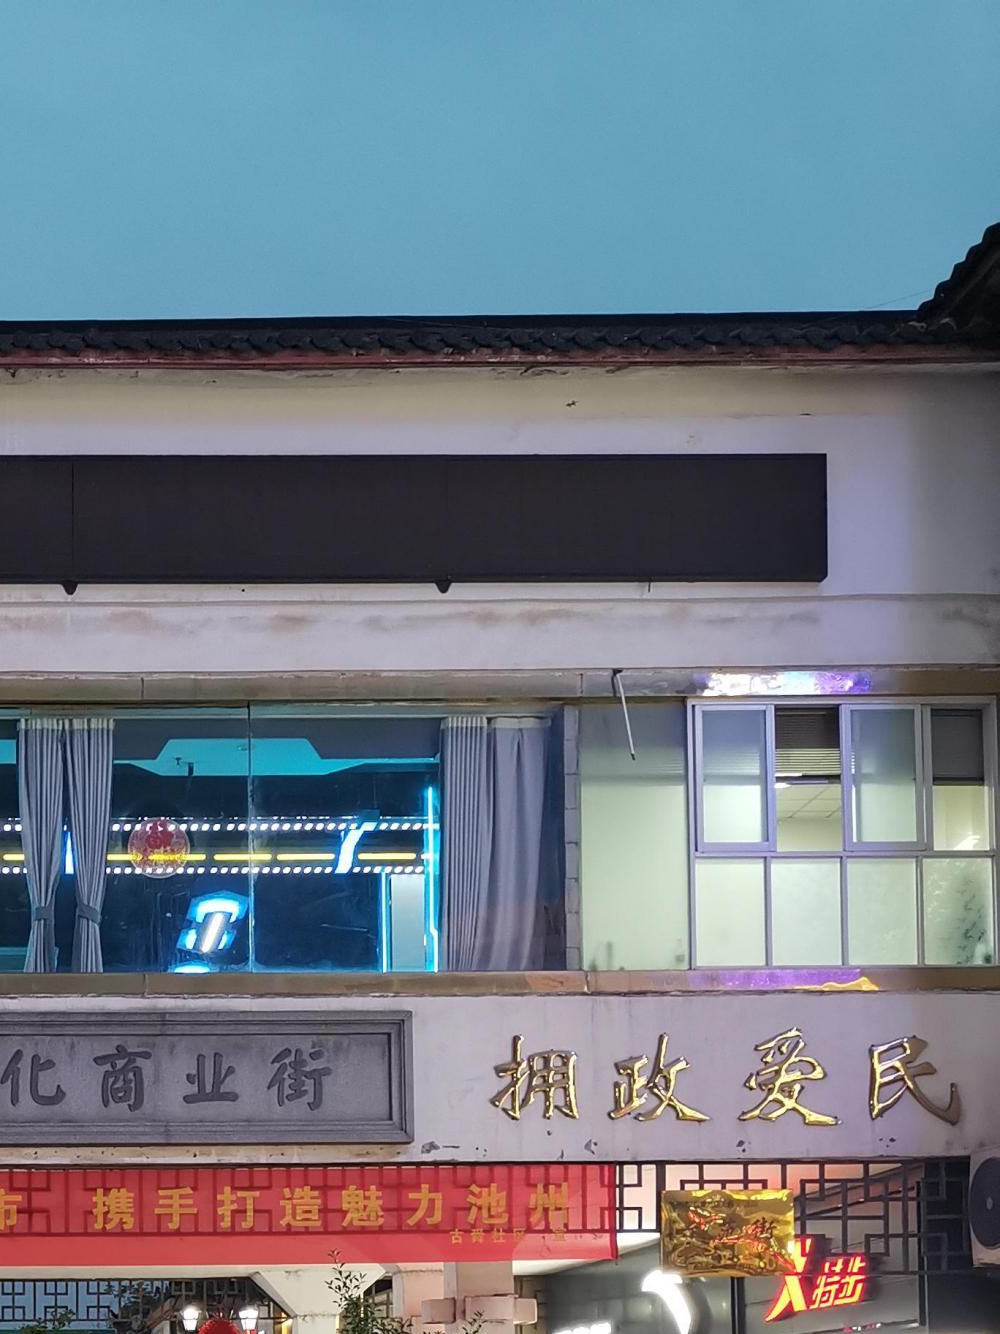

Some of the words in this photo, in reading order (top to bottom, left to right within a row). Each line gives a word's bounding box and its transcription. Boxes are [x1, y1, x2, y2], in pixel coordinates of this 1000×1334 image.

[491, 1027, 961, 1126] 拥政爱民
[92, 1183, 570, 1230] 携手打造魅力池州
[809, 1255, 868, 1310] 特步
